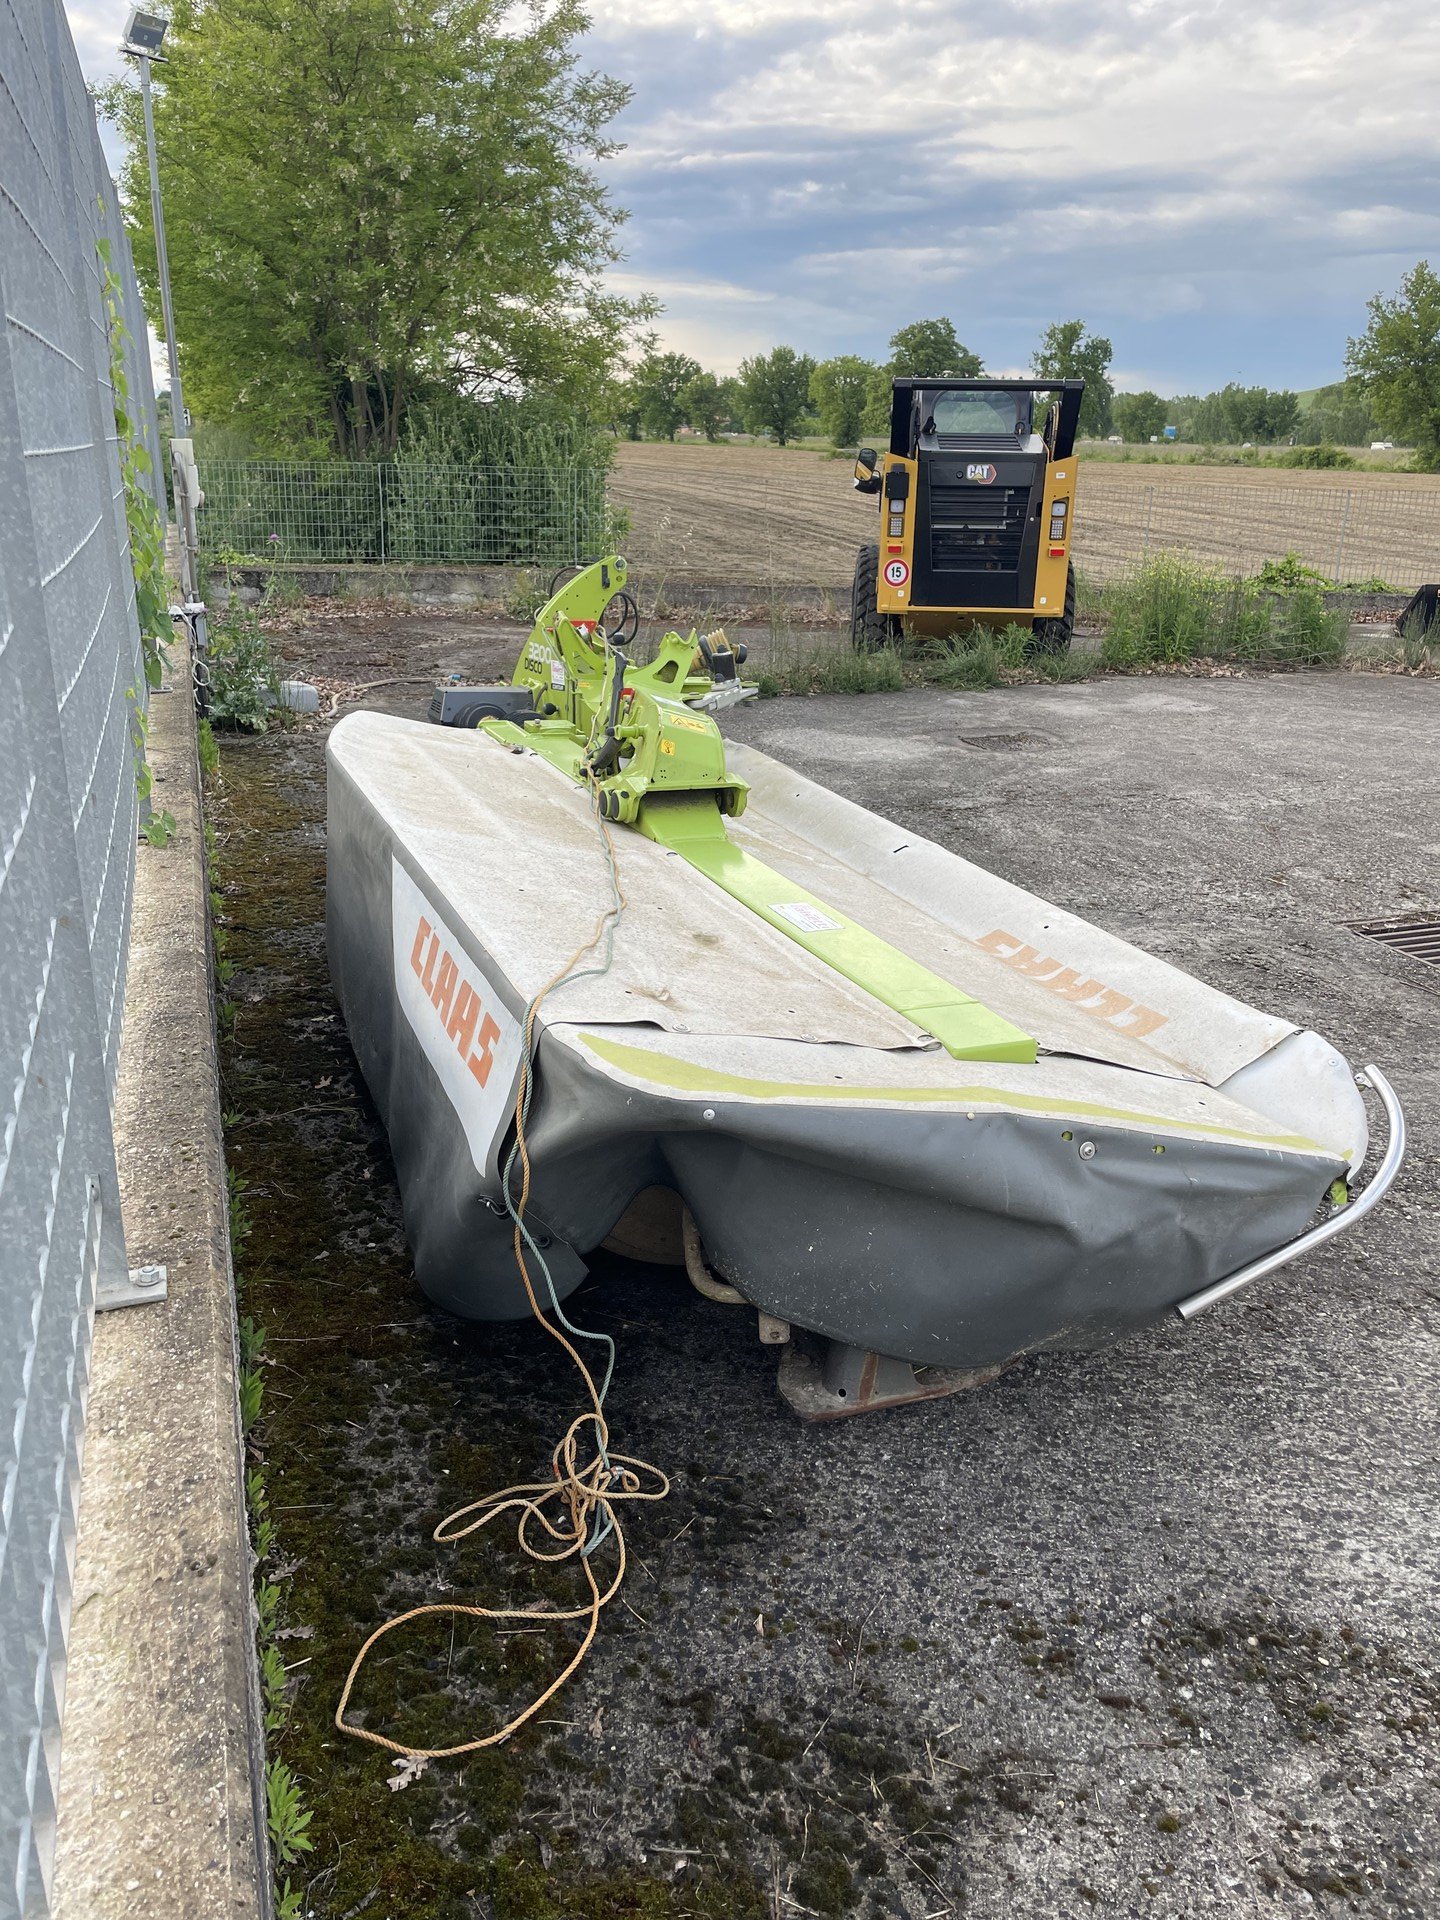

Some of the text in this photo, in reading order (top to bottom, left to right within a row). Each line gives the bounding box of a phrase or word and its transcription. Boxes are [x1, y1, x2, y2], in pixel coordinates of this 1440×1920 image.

[966, 464, 989, 480] CAT
[891, 566, 902, 578] 15
[528, 641, 552, 664] 3200
[524, 657, 543, 675] DISCO
[975, 928, 1169, 1039] CLAAS
[410, 915, 501, 1090] CLAAS
